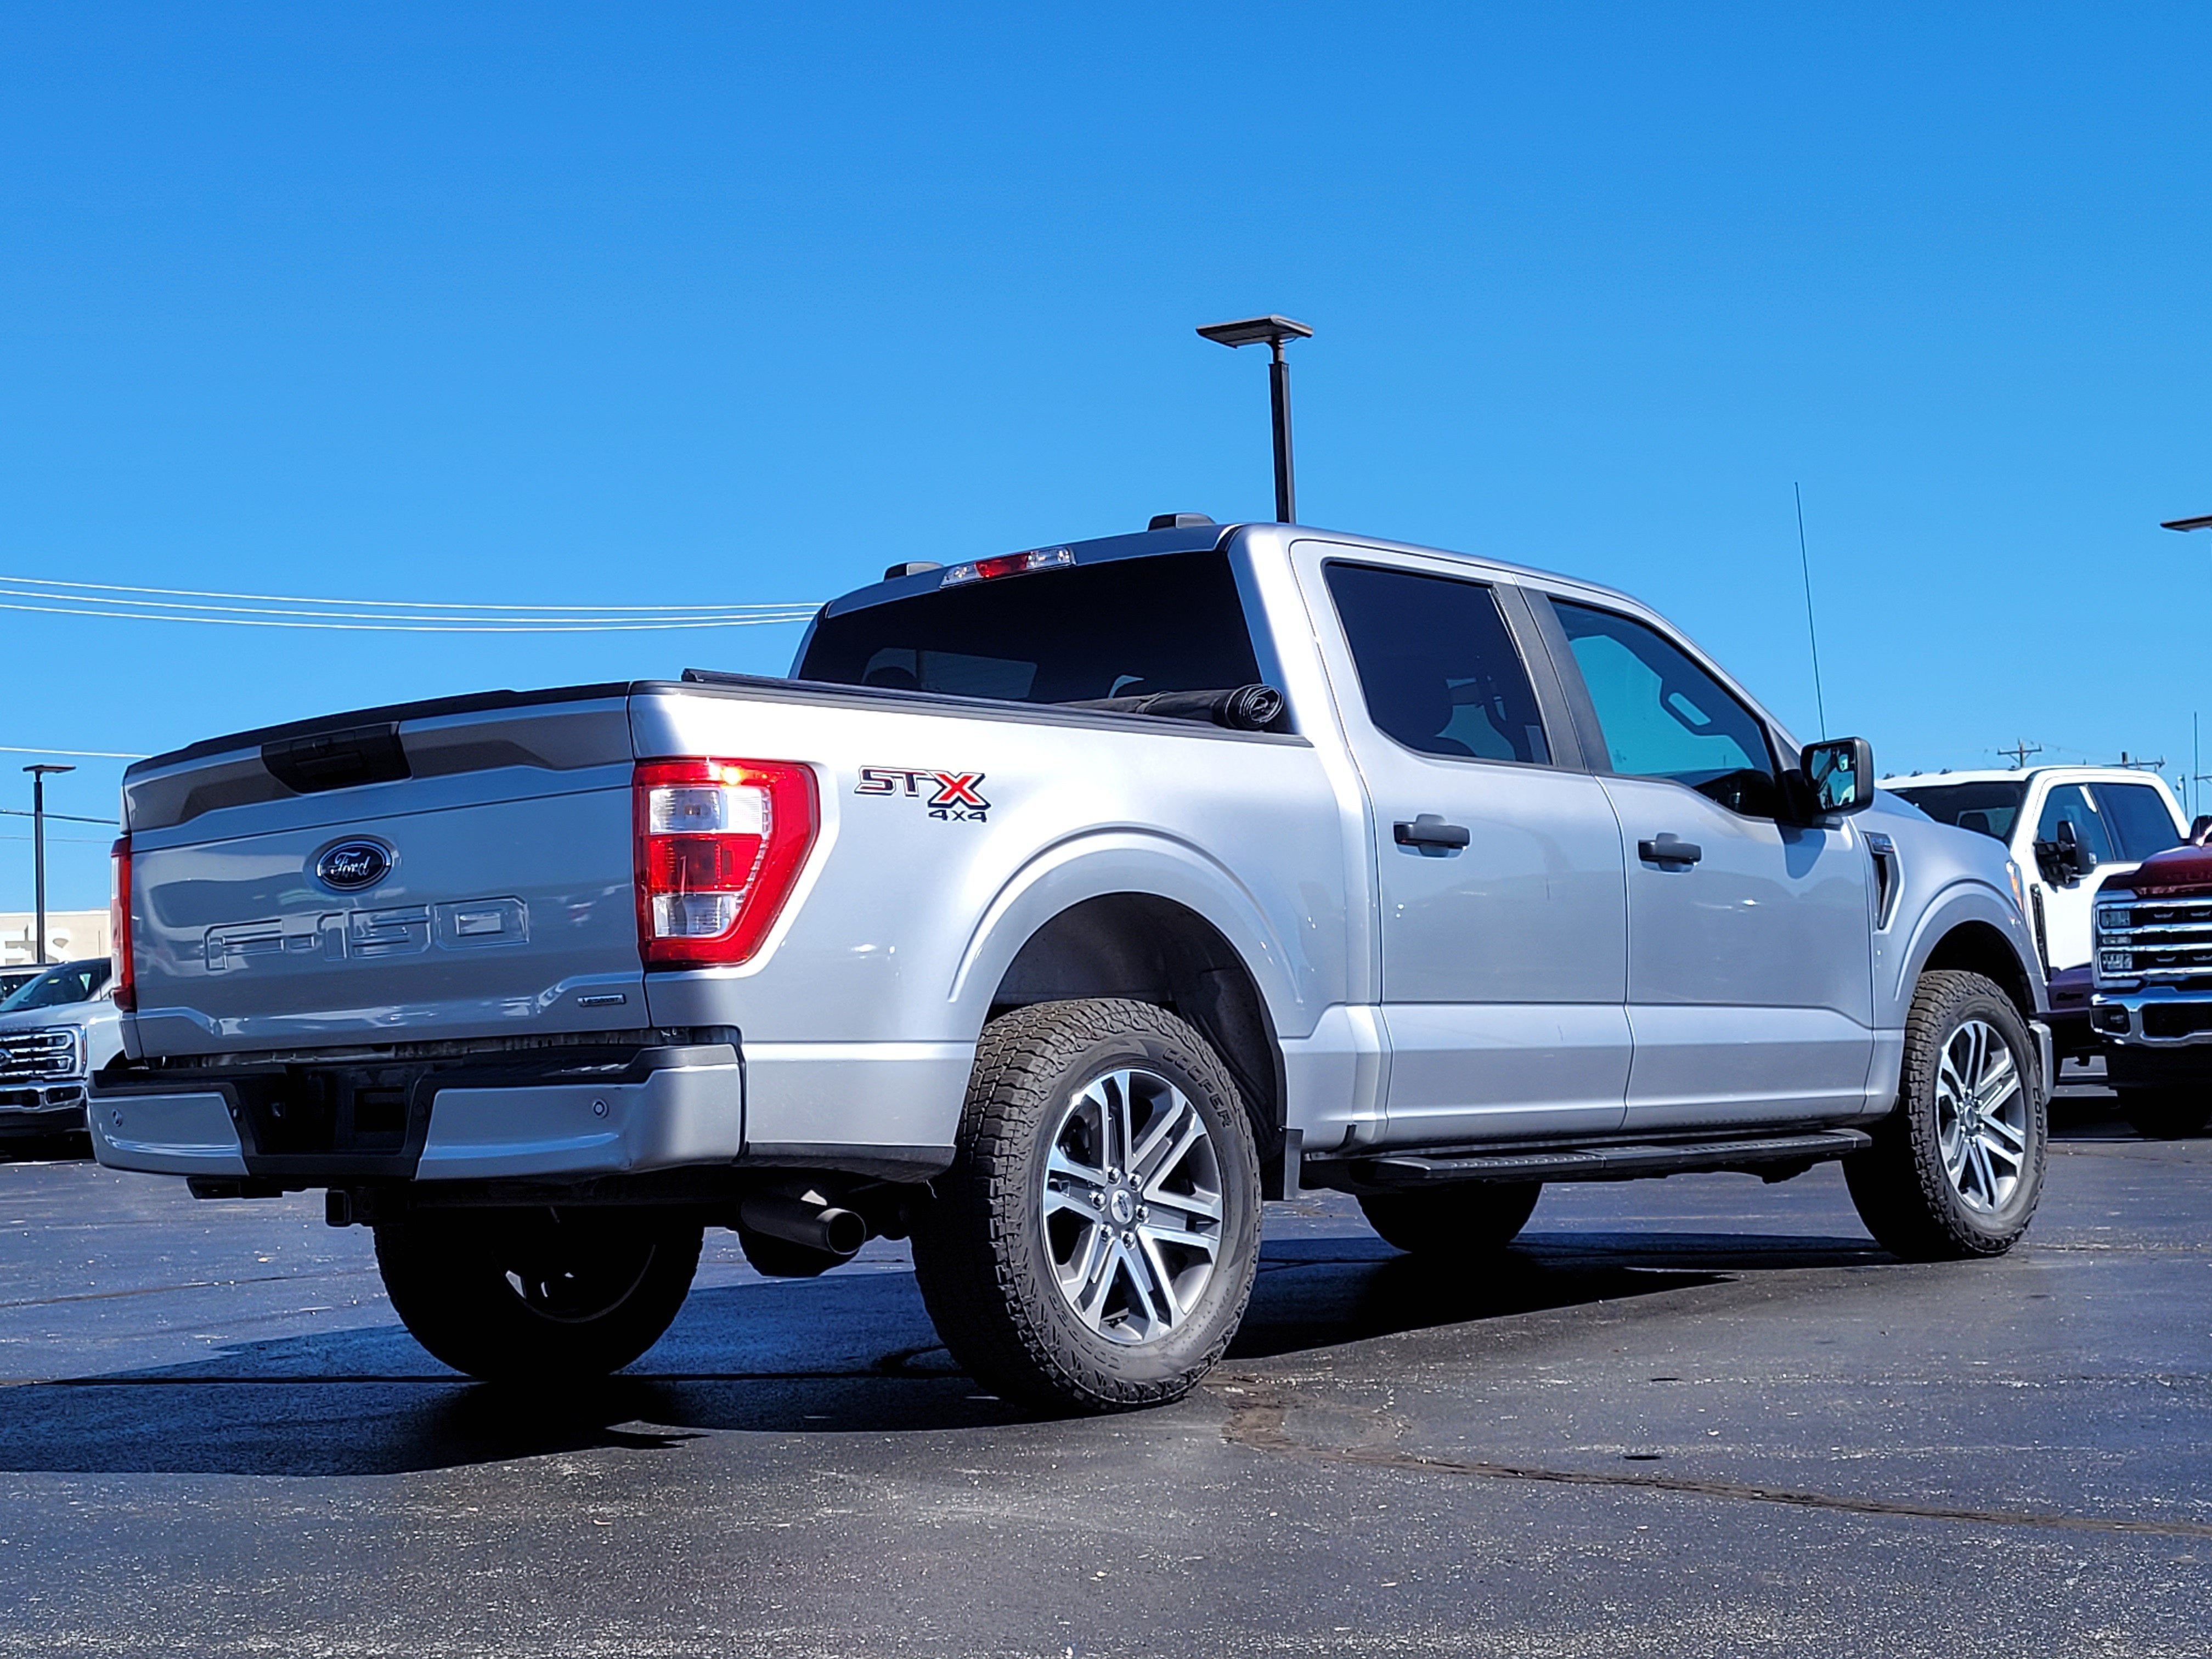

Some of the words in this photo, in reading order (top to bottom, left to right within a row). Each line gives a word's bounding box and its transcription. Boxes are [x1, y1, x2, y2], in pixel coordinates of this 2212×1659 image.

[854, 765, 991, 810] STX
[331, 851, 371, 879] Ford
[206, 895, 529, 971] F-150
[1163, 1047, 1232, 1128] COOPER
